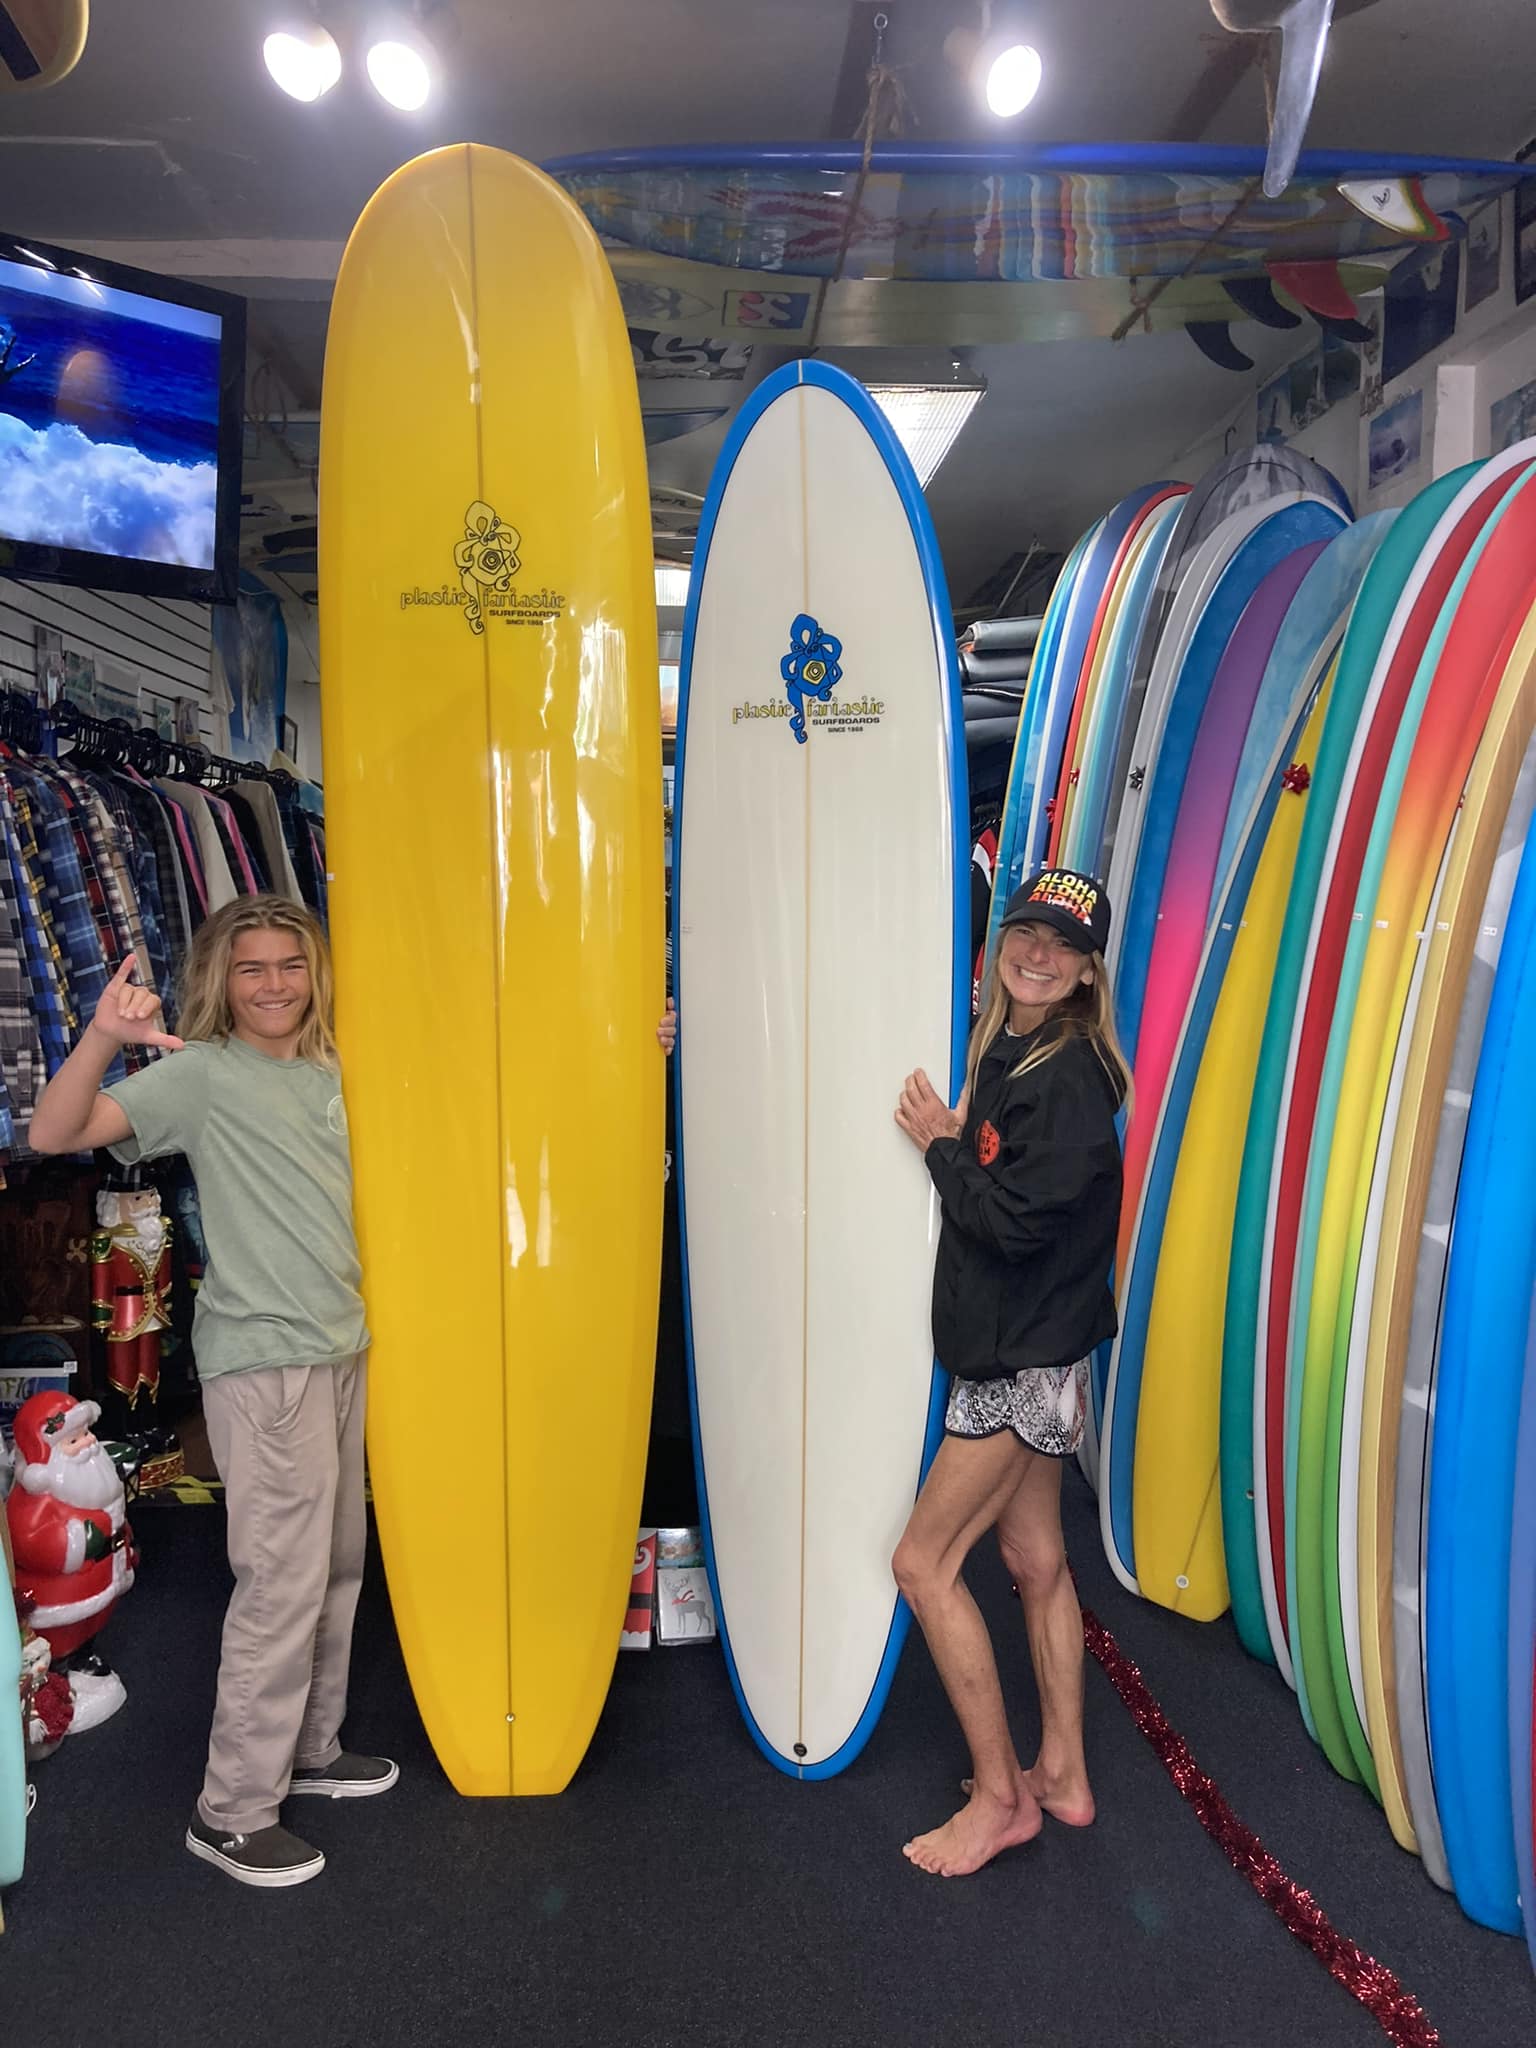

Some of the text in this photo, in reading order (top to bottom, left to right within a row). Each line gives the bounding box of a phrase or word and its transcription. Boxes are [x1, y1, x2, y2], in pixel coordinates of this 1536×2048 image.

[400, 585, 566, 610] plastic fantastic
[732, 695, 885, 724] plastic fantastic
[812, 717, 880, 726] SURFBOARDS
[1033, 882, 1093, 914] ALOHA
[1038, 872, 1097, 904] ALOHA
